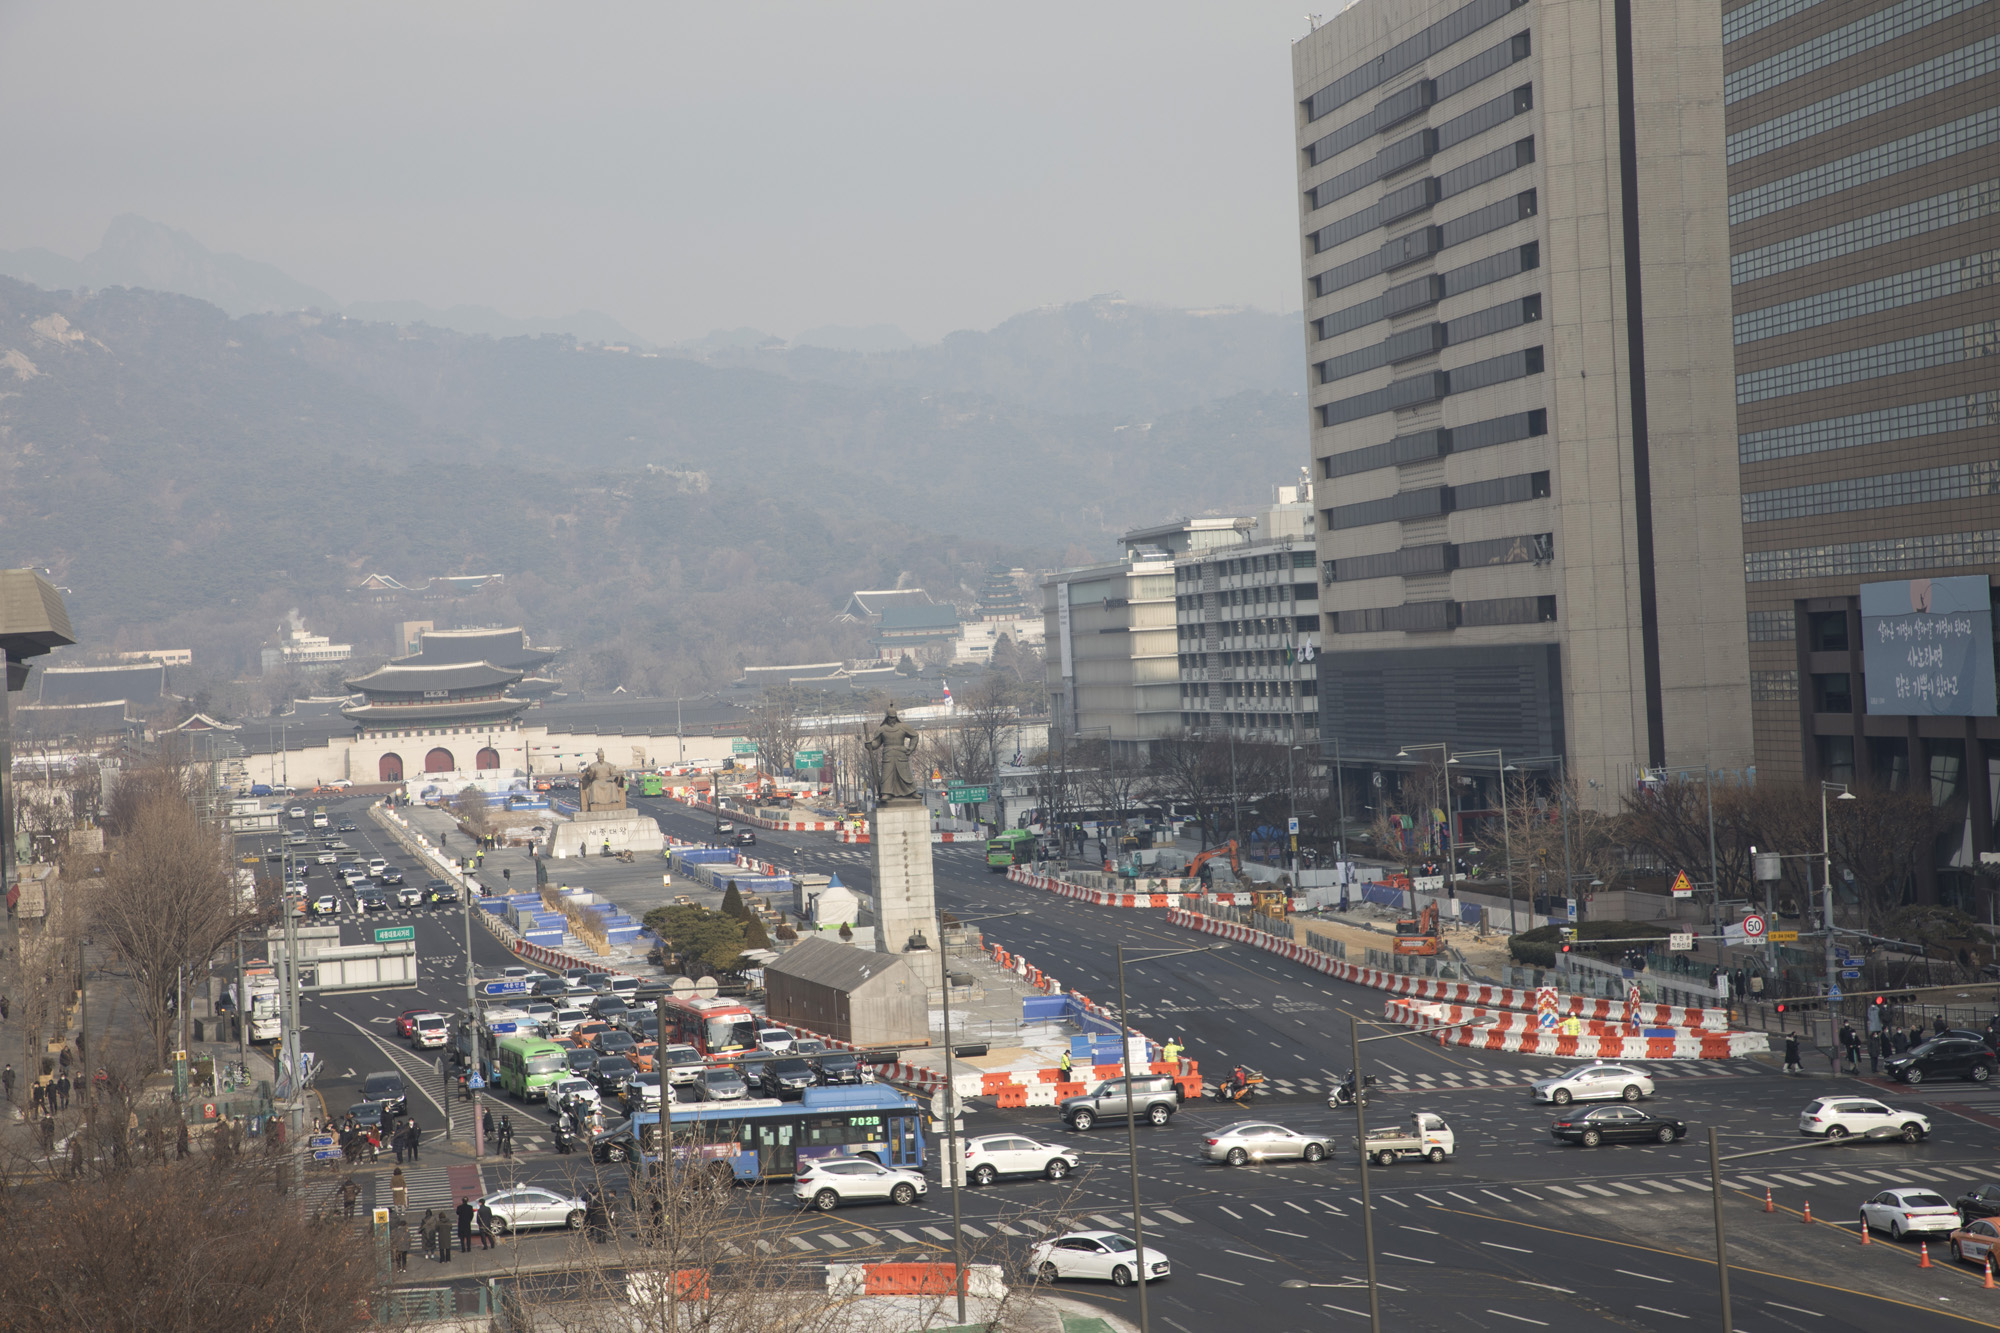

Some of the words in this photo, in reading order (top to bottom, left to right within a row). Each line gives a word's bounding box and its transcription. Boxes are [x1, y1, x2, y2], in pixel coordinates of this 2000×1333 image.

[1877, 619, 1895, 643] 살아온
[1896, 620, 1913, 642] 기적이
[1914, 617, 1934, 641] 살아갈
[1936, 617, 1953, 639] 기적이
[1954, 617, 1972, 638] 된다고
[1907, 644, 1943, 668] 사노라면
[1896, 672, 1910, 698] 많은
[1912, 673, 1934, 700] 기쁨이
[1936, 674, 1959, 698] 있다고
[589, 826, 627, 836] 세종대왕
[1748, 920, 1761, 932] 50
[380, 930, 410, 938] 세종대로사거리
[850, 1116, 880, 1126] 702B
